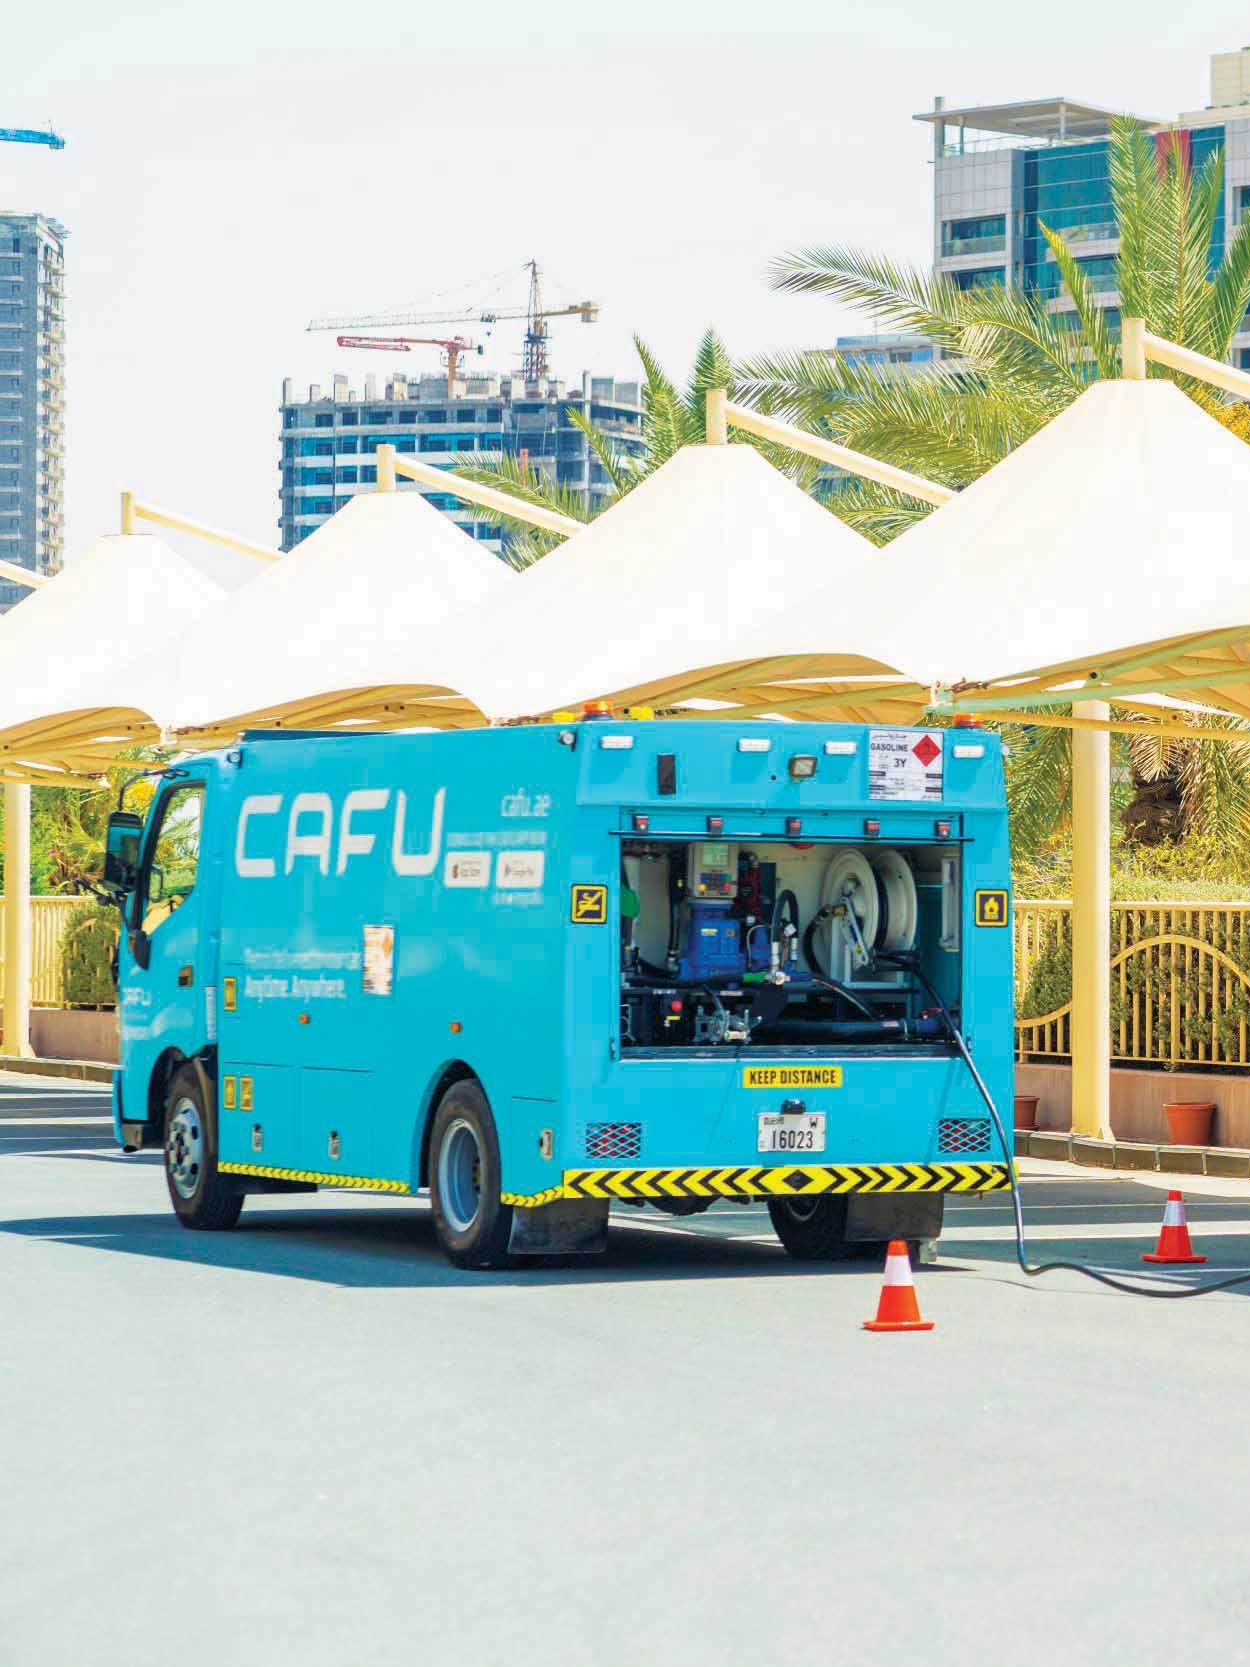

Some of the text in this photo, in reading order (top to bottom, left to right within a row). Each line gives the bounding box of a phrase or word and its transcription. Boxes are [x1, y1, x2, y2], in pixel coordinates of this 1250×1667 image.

[870, 743, 909, 752] GASOLINE
[894, 758, 907, 768] 3Y
[234, 786, 446, 878] CAFU
[750, 1069, 837, 1085] KEEP DISTANCE
[809, 1117, 818, 1129] W
[772, 1130, 814, 1150] 16023
